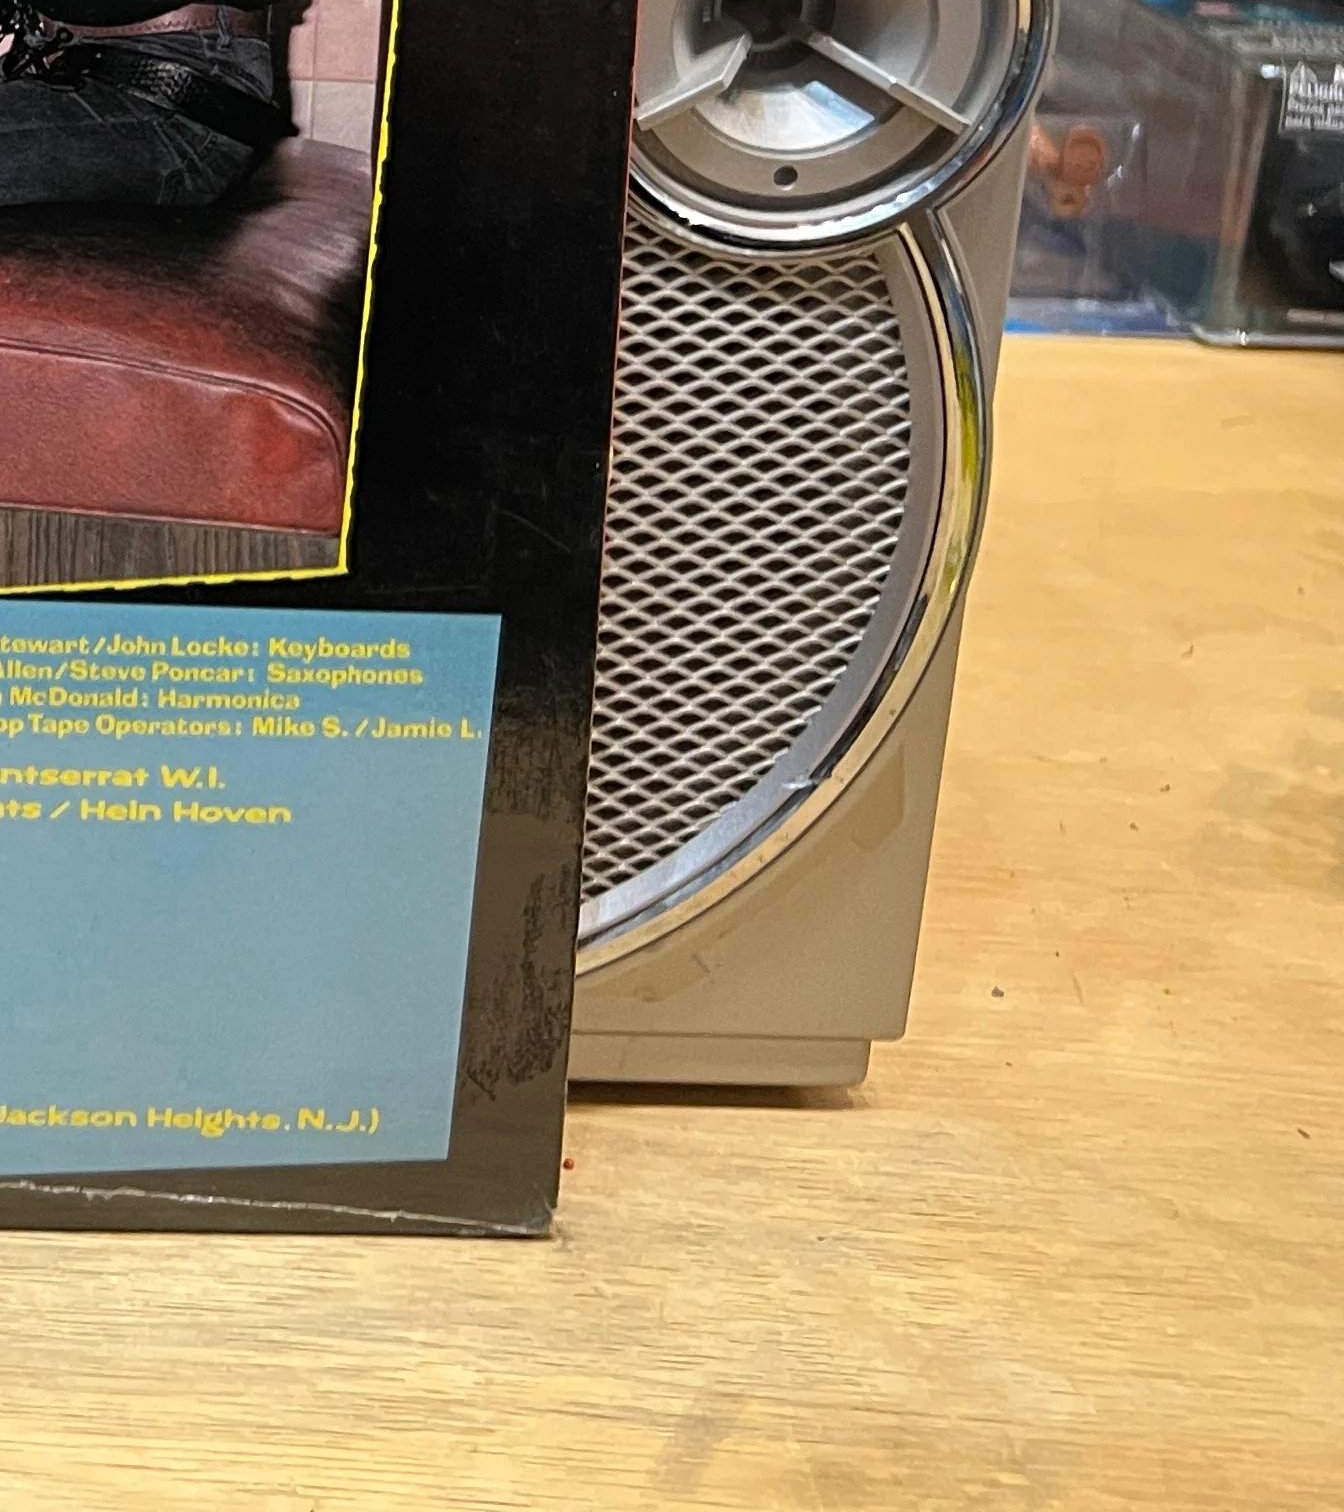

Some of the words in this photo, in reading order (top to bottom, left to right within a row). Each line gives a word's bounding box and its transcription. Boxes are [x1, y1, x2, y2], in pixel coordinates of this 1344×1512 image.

[267, 637, 410, 665] Keyboards
[267, 661, 424, 689] Saxophones
[157, 688, 300, 710] Harmonica
[27, 712, 90, 739] Tape
[252, 716, 315, 736] Mike
[80, 799, 161, 821] Hein
[173, 801, 292, 824] Hoven
